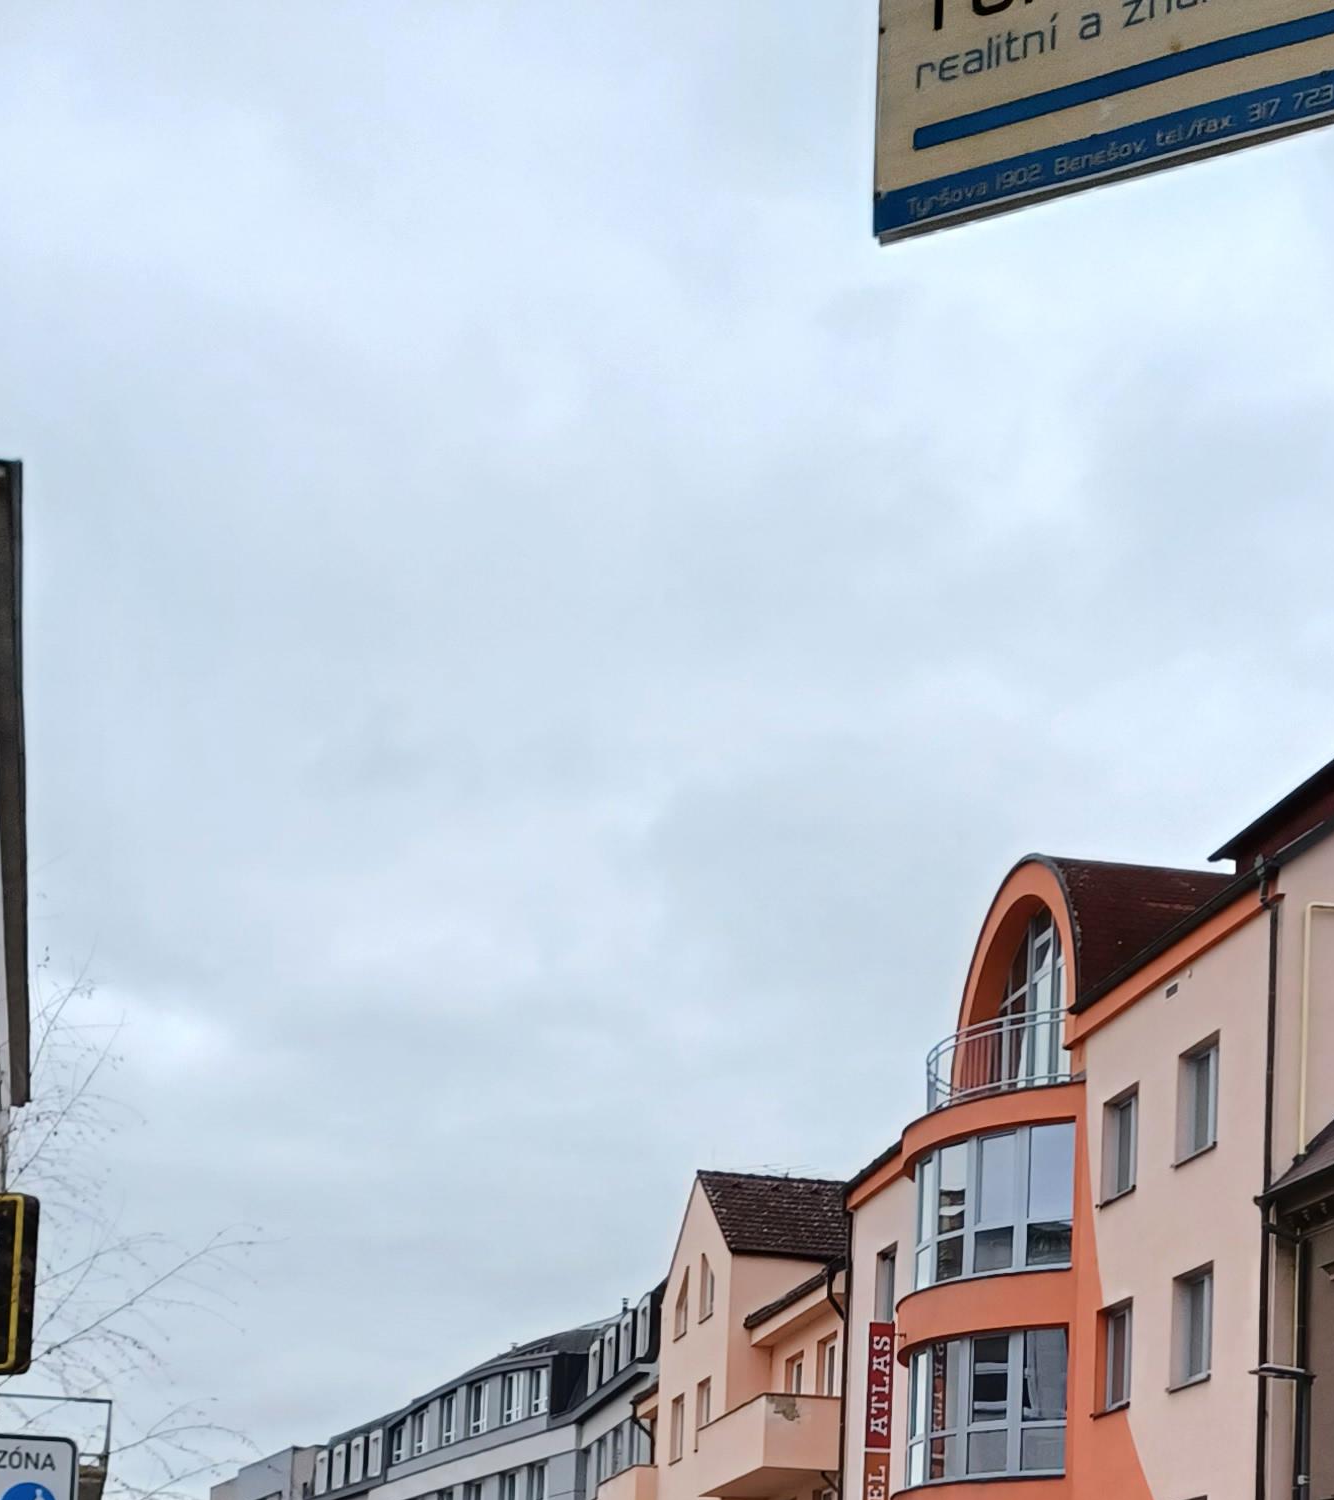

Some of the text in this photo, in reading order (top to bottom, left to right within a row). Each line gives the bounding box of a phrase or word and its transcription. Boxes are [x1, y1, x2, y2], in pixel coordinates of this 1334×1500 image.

[916, 12, 1058, 89] realitní
[1078, 12, 1101, 41] a
[1247, 97, 1281, 123] 317
[1291, 83, 1334, 112] 723
[870, 1334, 891, 1437] ATLAS
